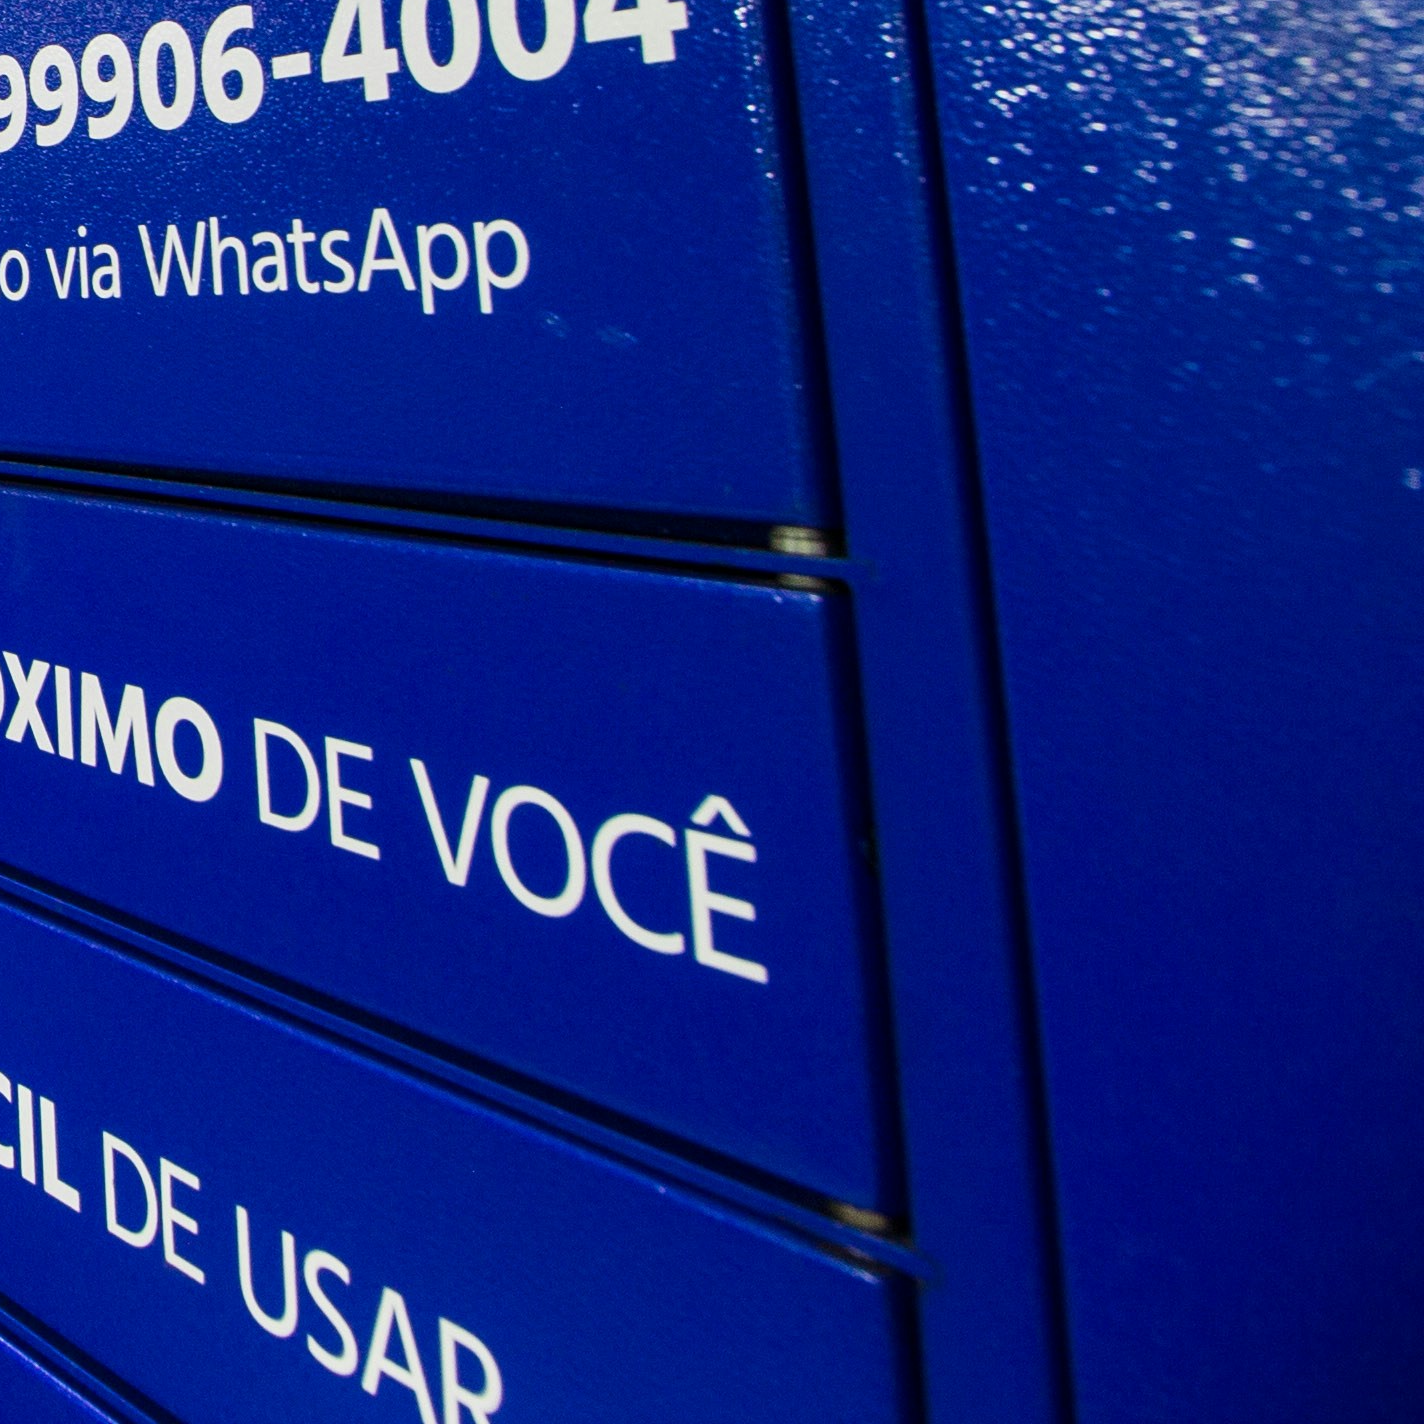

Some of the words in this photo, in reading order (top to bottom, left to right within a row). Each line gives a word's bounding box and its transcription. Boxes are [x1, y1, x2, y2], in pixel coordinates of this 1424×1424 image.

[44, 226, 121, 300] via
[138, 207, 530, 316] WhatsApp
[253, 718, 379, 860] DE
[410, 757, 768, 984] VOCÊ
[103, 1130, 204, 1285] DE
[236, 1204, 504, 1424] USAR
